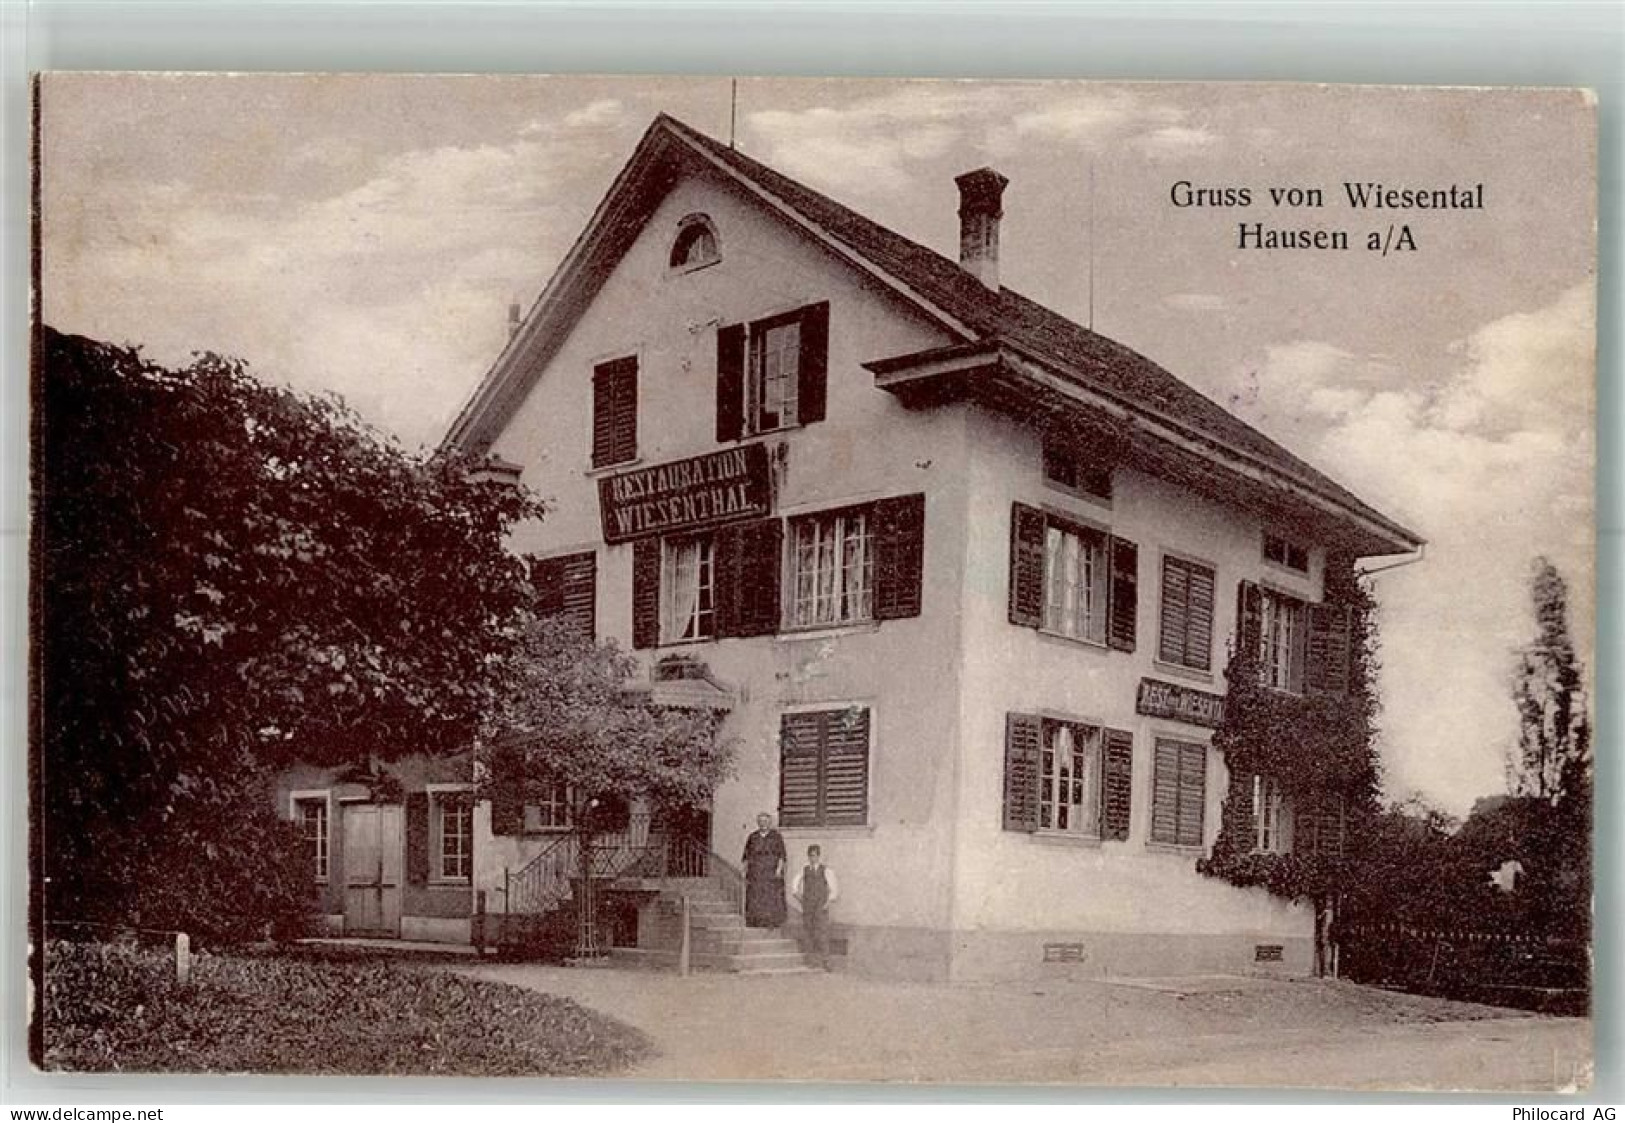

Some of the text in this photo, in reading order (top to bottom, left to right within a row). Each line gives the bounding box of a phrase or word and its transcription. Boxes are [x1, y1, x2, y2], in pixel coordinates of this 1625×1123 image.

[1170, 180, 1484, 210] Gruss von Wiesental
[1238, 222, 1417, 257] Hausen a/A
[611, 449, 747, 503] RESTAURATION
